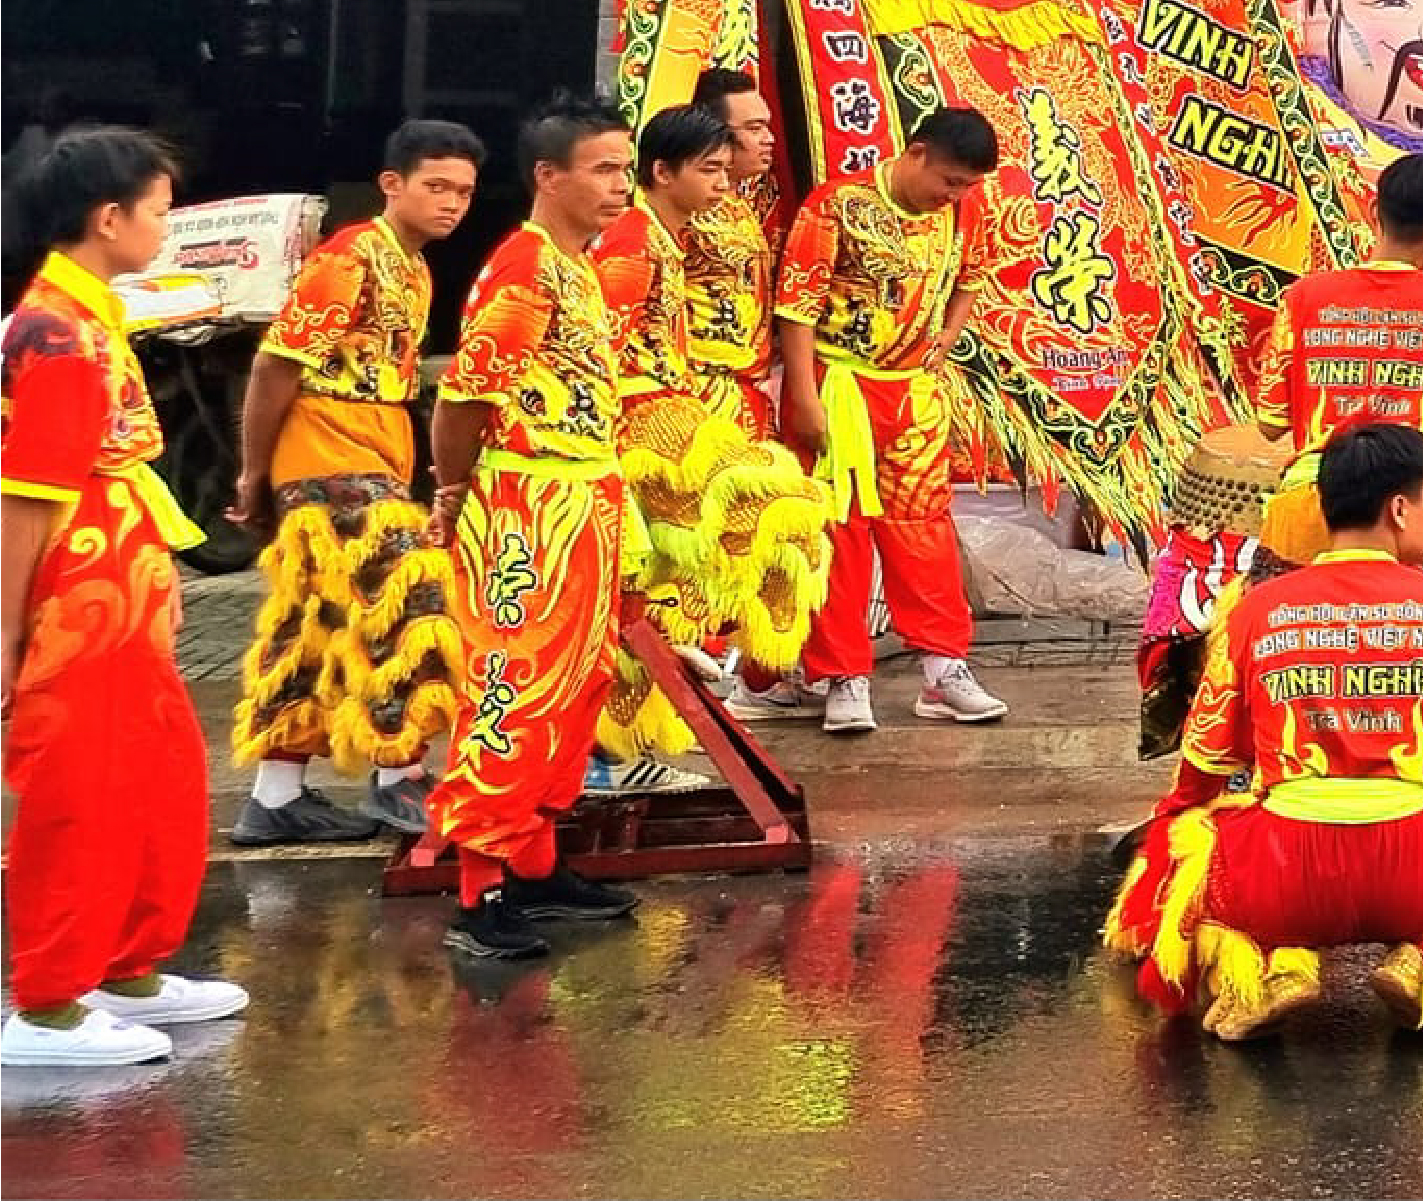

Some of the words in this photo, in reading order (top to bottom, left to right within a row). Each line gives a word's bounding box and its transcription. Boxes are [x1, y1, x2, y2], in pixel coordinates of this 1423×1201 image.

[1305, 358, 1369, 386] VINH
[1259, 664, 1336, 705] VINH
[1346, 707, 1402, 732] Vinh
